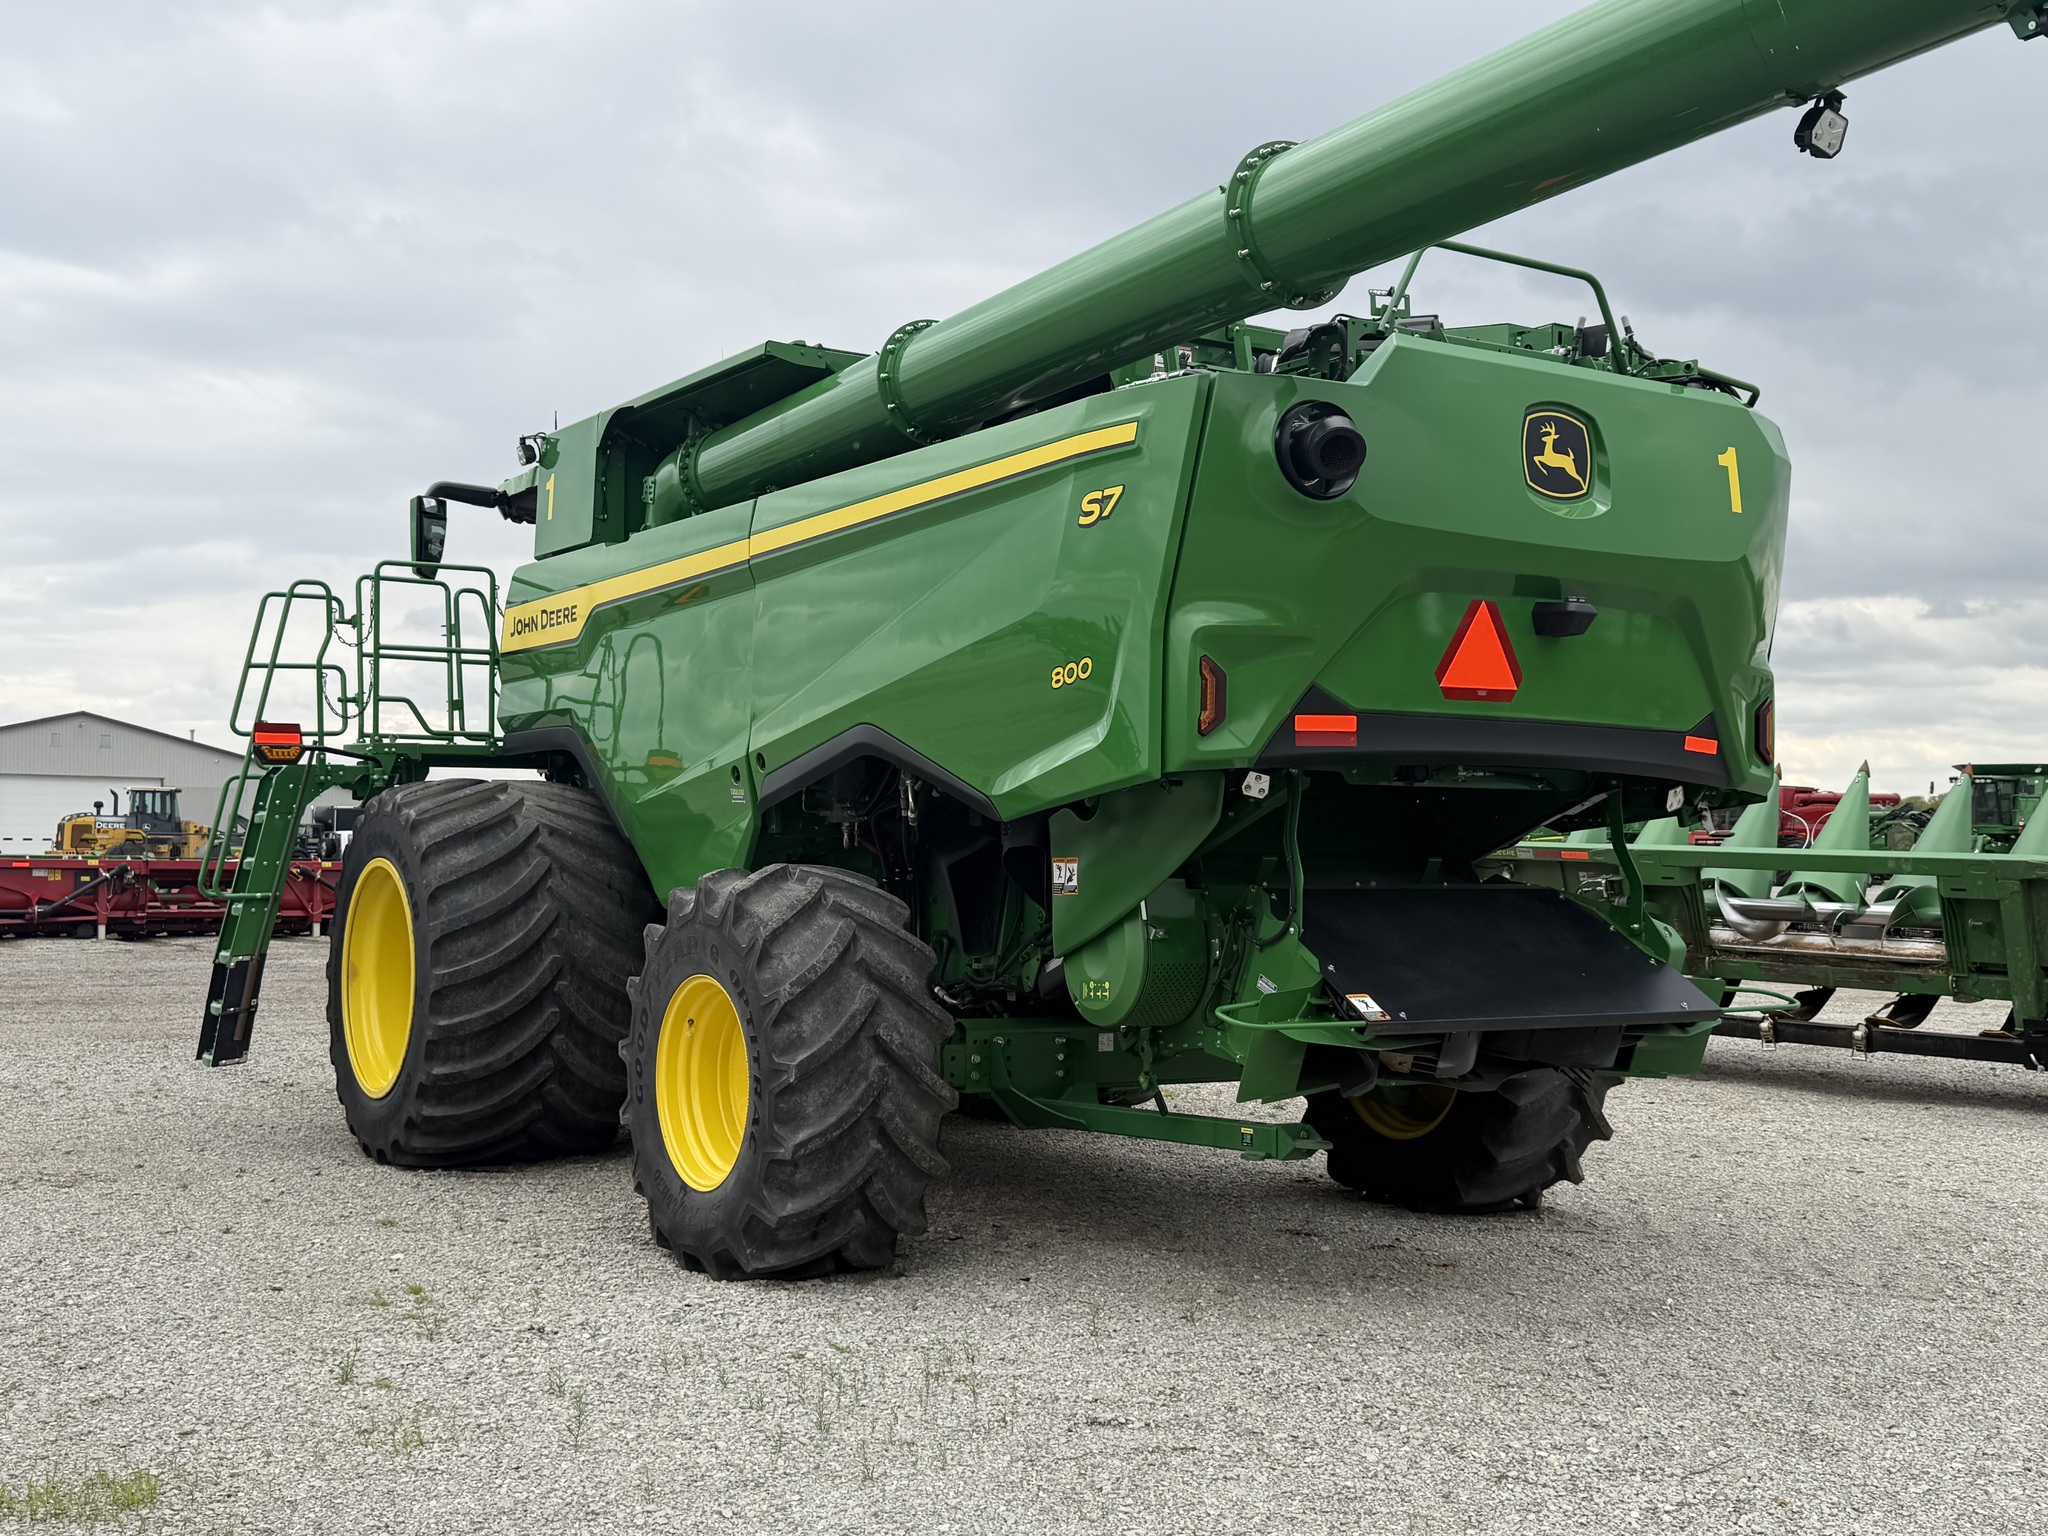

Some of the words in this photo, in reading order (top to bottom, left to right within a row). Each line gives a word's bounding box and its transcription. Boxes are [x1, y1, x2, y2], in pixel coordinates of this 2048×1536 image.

[545, 472, 555, 521] 1
[1717, 446, 1743, 514] 1
[1078, 485, 1125, 527] S7
[510, 614, 538, 637] JOHN
[540, 604, 578, 630] DEERE
[1050, 656, 1093, 690] 800
[95, 821, 126, 830] DEERE
[729, 968, 762, 1156] OPTITRAC
